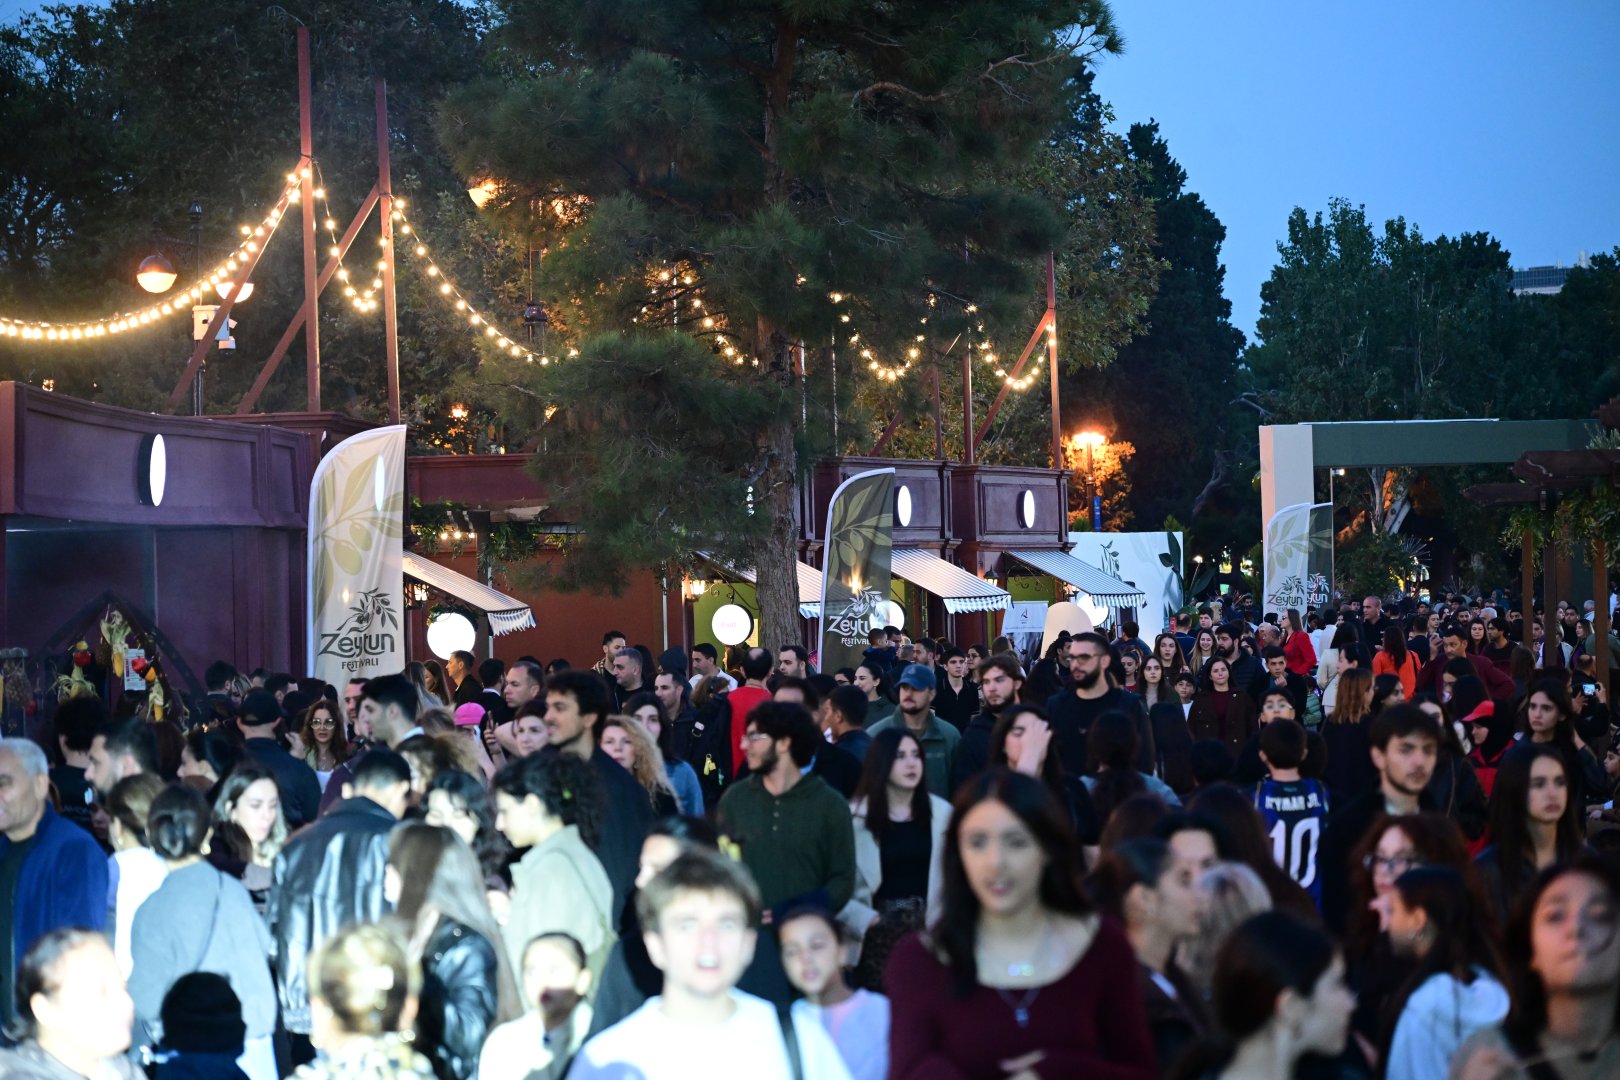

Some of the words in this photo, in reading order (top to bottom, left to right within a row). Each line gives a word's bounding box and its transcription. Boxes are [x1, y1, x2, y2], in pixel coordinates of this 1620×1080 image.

[1267, 594, 1303, 607] Zeytun
[1307, 593, 1328, 604] ytun
[826, 615, 870, 636] Zeytu
[318, 633, 395, 658] Zeytun
[841, 637, 871, 647] FESTİVAL
[1269, 817, 1320, 888] 10
